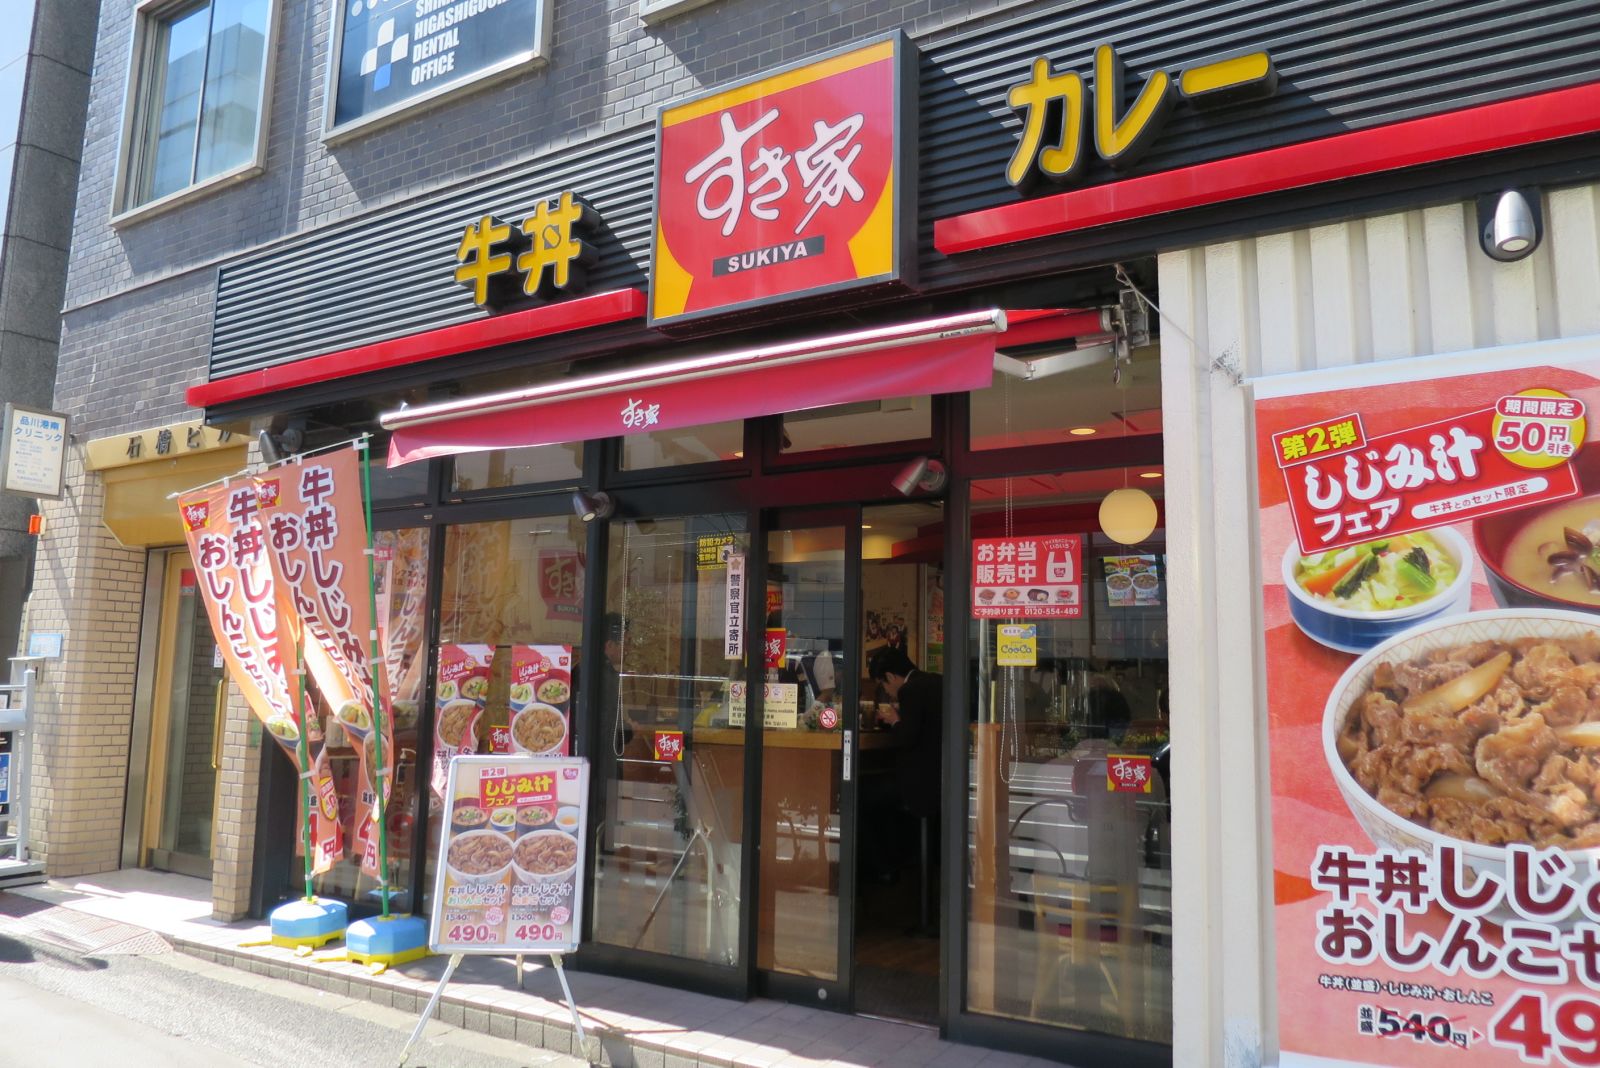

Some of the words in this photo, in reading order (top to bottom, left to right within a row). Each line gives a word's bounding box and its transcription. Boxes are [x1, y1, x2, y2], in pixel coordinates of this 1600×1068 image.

[415, 0, 456, 18] SHIN
[413, 27, 460, 64] DENTAL
[411, 51, 455, 86] OFFICE
[1006, 42, 1271, 186] カレー
[685, 107, 865, 237] すき家
[454, 189, 584, 307] 牛丼
[727, 241, 808, 273] SUKIYA
[620, 397, 661, 429] すき家
[1504, 399, 1576, 417] 期間限定
[15, 427, 63, 442] クリニック
[1280, 420, 1358, 461] 第2弾
[1304, 427, 1483, 510] しじみ汁
[1429, 483, 1530, 514] 牛丼とのセット限定
[1314, 498, 1400, 543] フェア
[977, 541, 1037, 562] お弁当
[976, 563, 1037, 584] 販売中
[728, 574, 741, 656] 警察官立寄所
[485, 775, 553, 797] しじみ汁
[1112, 758, 1146, 783] すき家
[486, 795, 515, 808] フェア
[1317, 846, 1600, 915] 牛丼しじ
[448, 925, 497, 941] 490円
[514, 924, 563, 941] 490円
